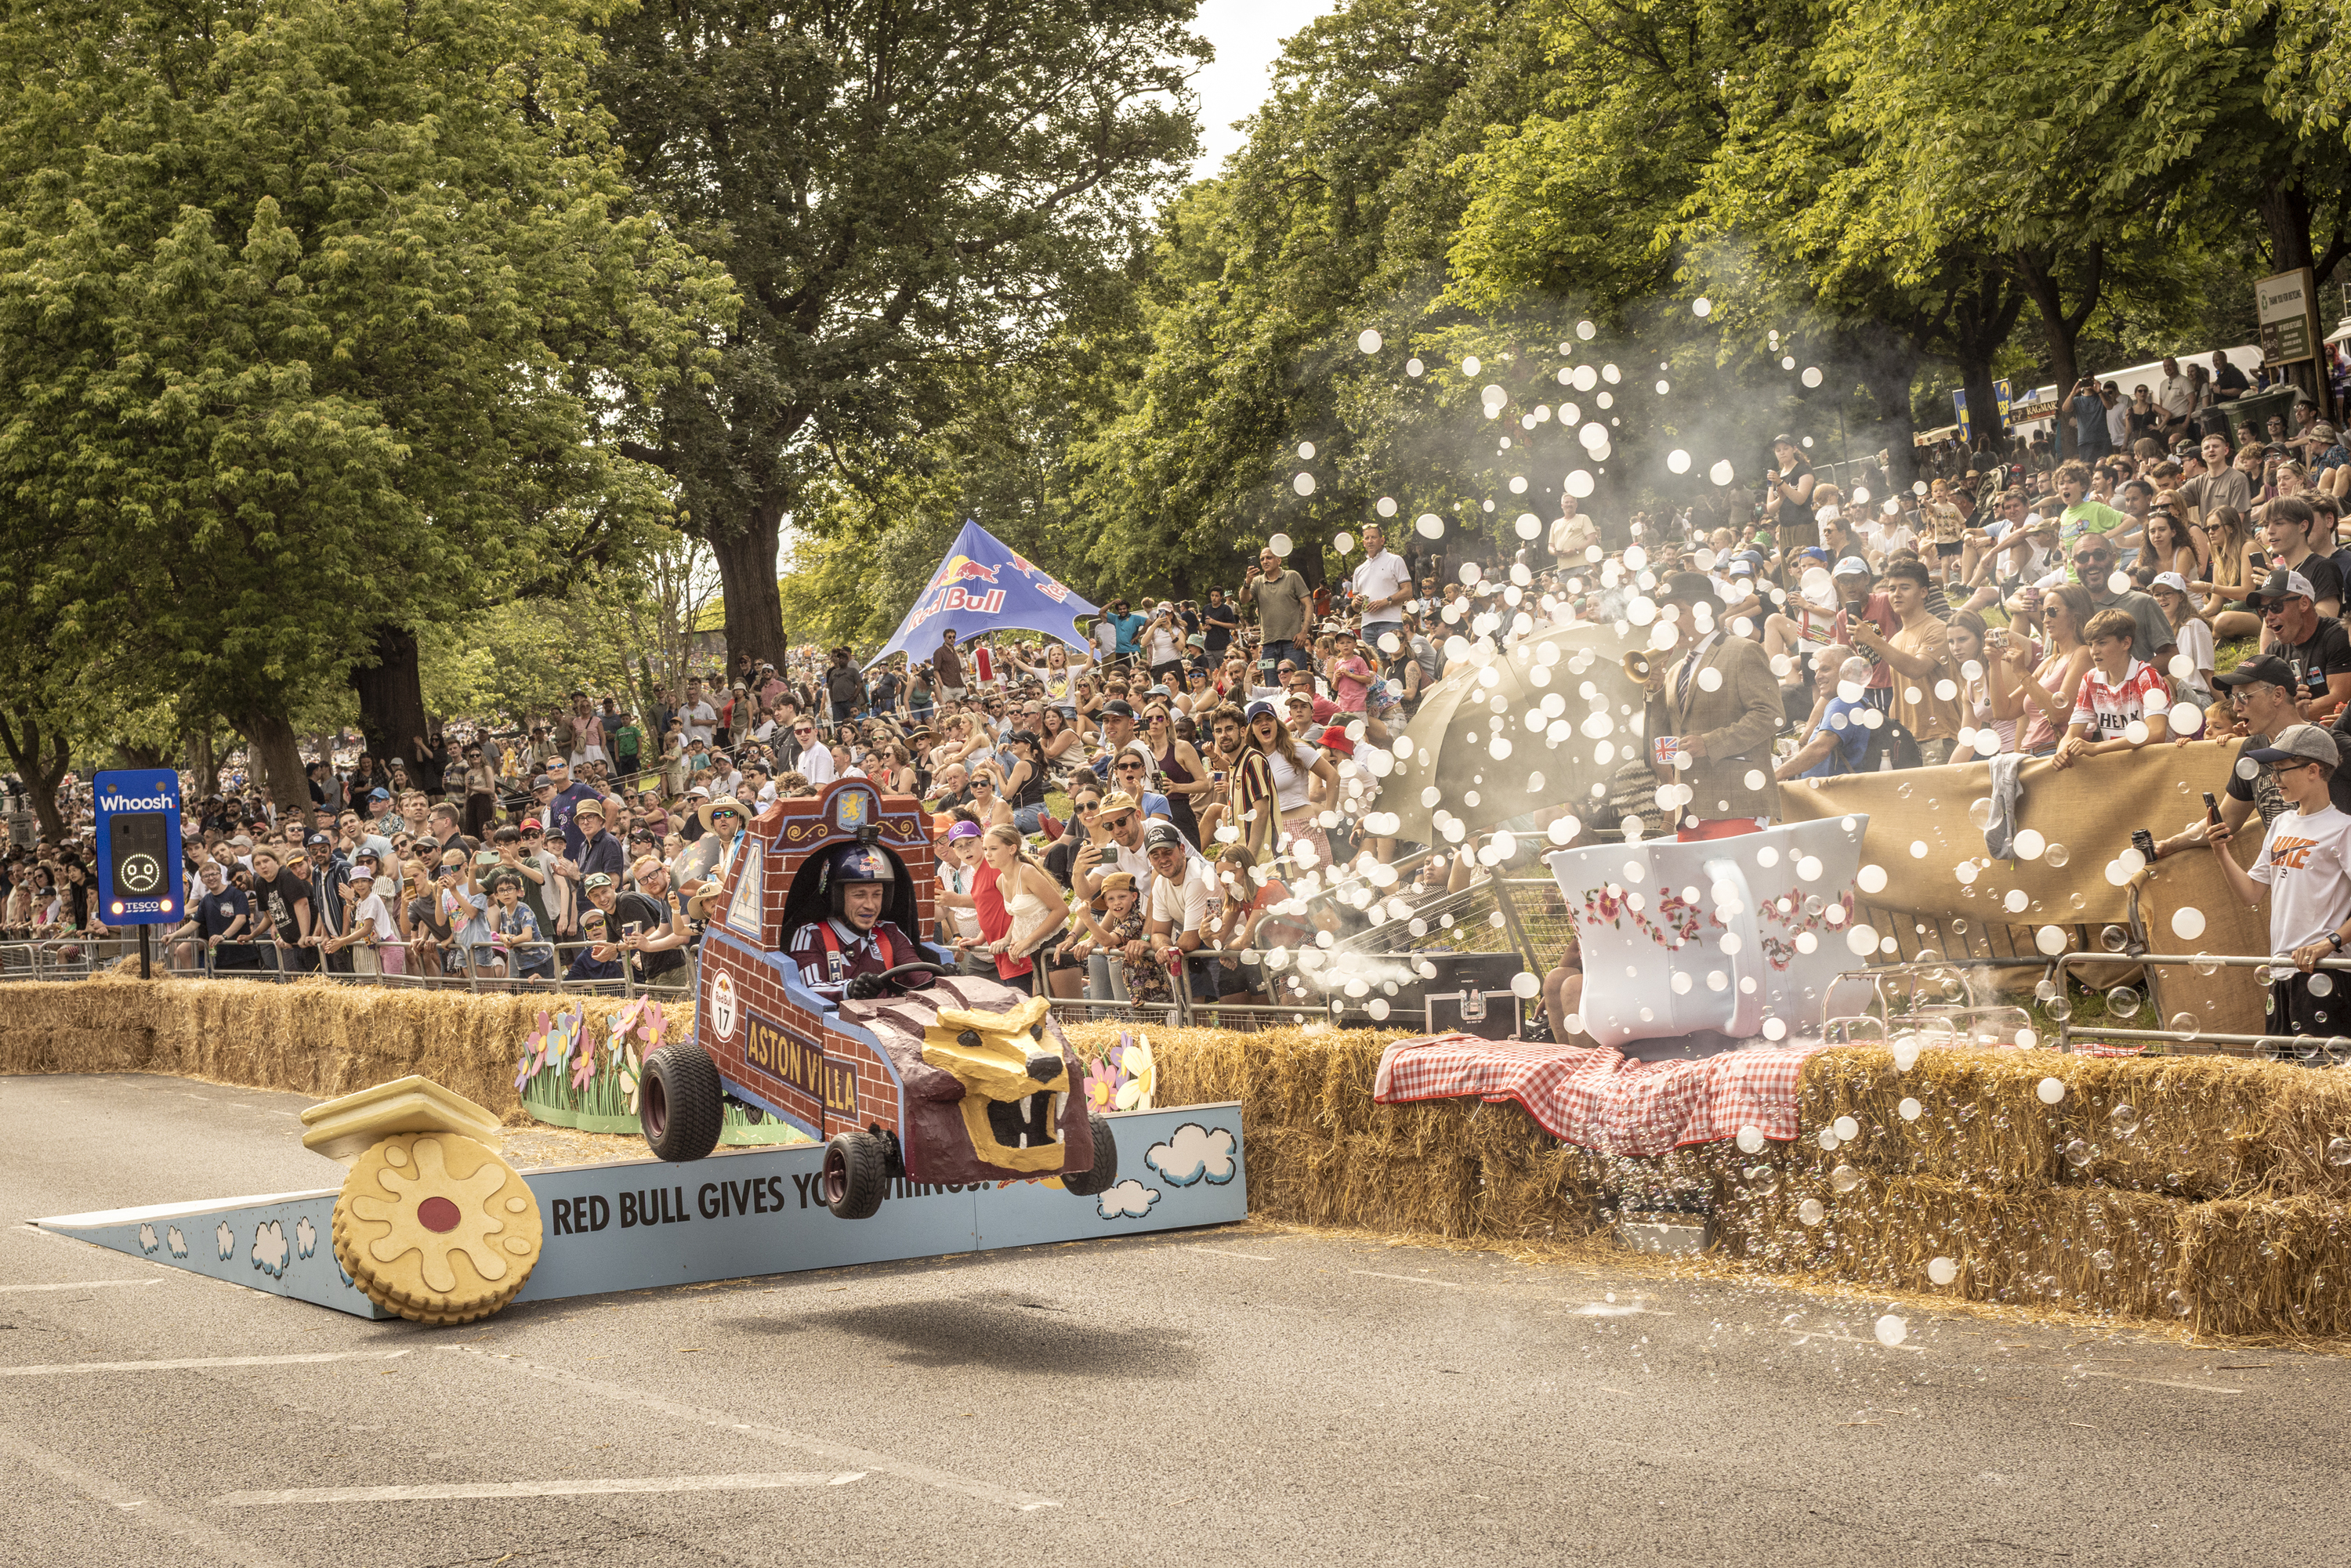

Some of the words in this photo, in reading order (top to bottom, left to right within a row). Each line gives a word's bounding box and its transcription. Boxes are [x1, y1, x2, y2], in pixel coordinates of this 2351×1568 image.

[2026, 400, 2059, 415] RAGMAR
[904, 588, 947, 636] Red
[943, 587, 1007, 614] Bull
[125, 901, 159, 910] TESCO
[718, 1006, 730, 1031] 17
[748, 1021, 801, 1085] ASTON
[806, 1049, 856, 1114] VILLA
[552, 1195, 610, 1237] RED
[619, 1186, 690, 1229] BULL
[697, 1175, 785, 1220] GIVES
